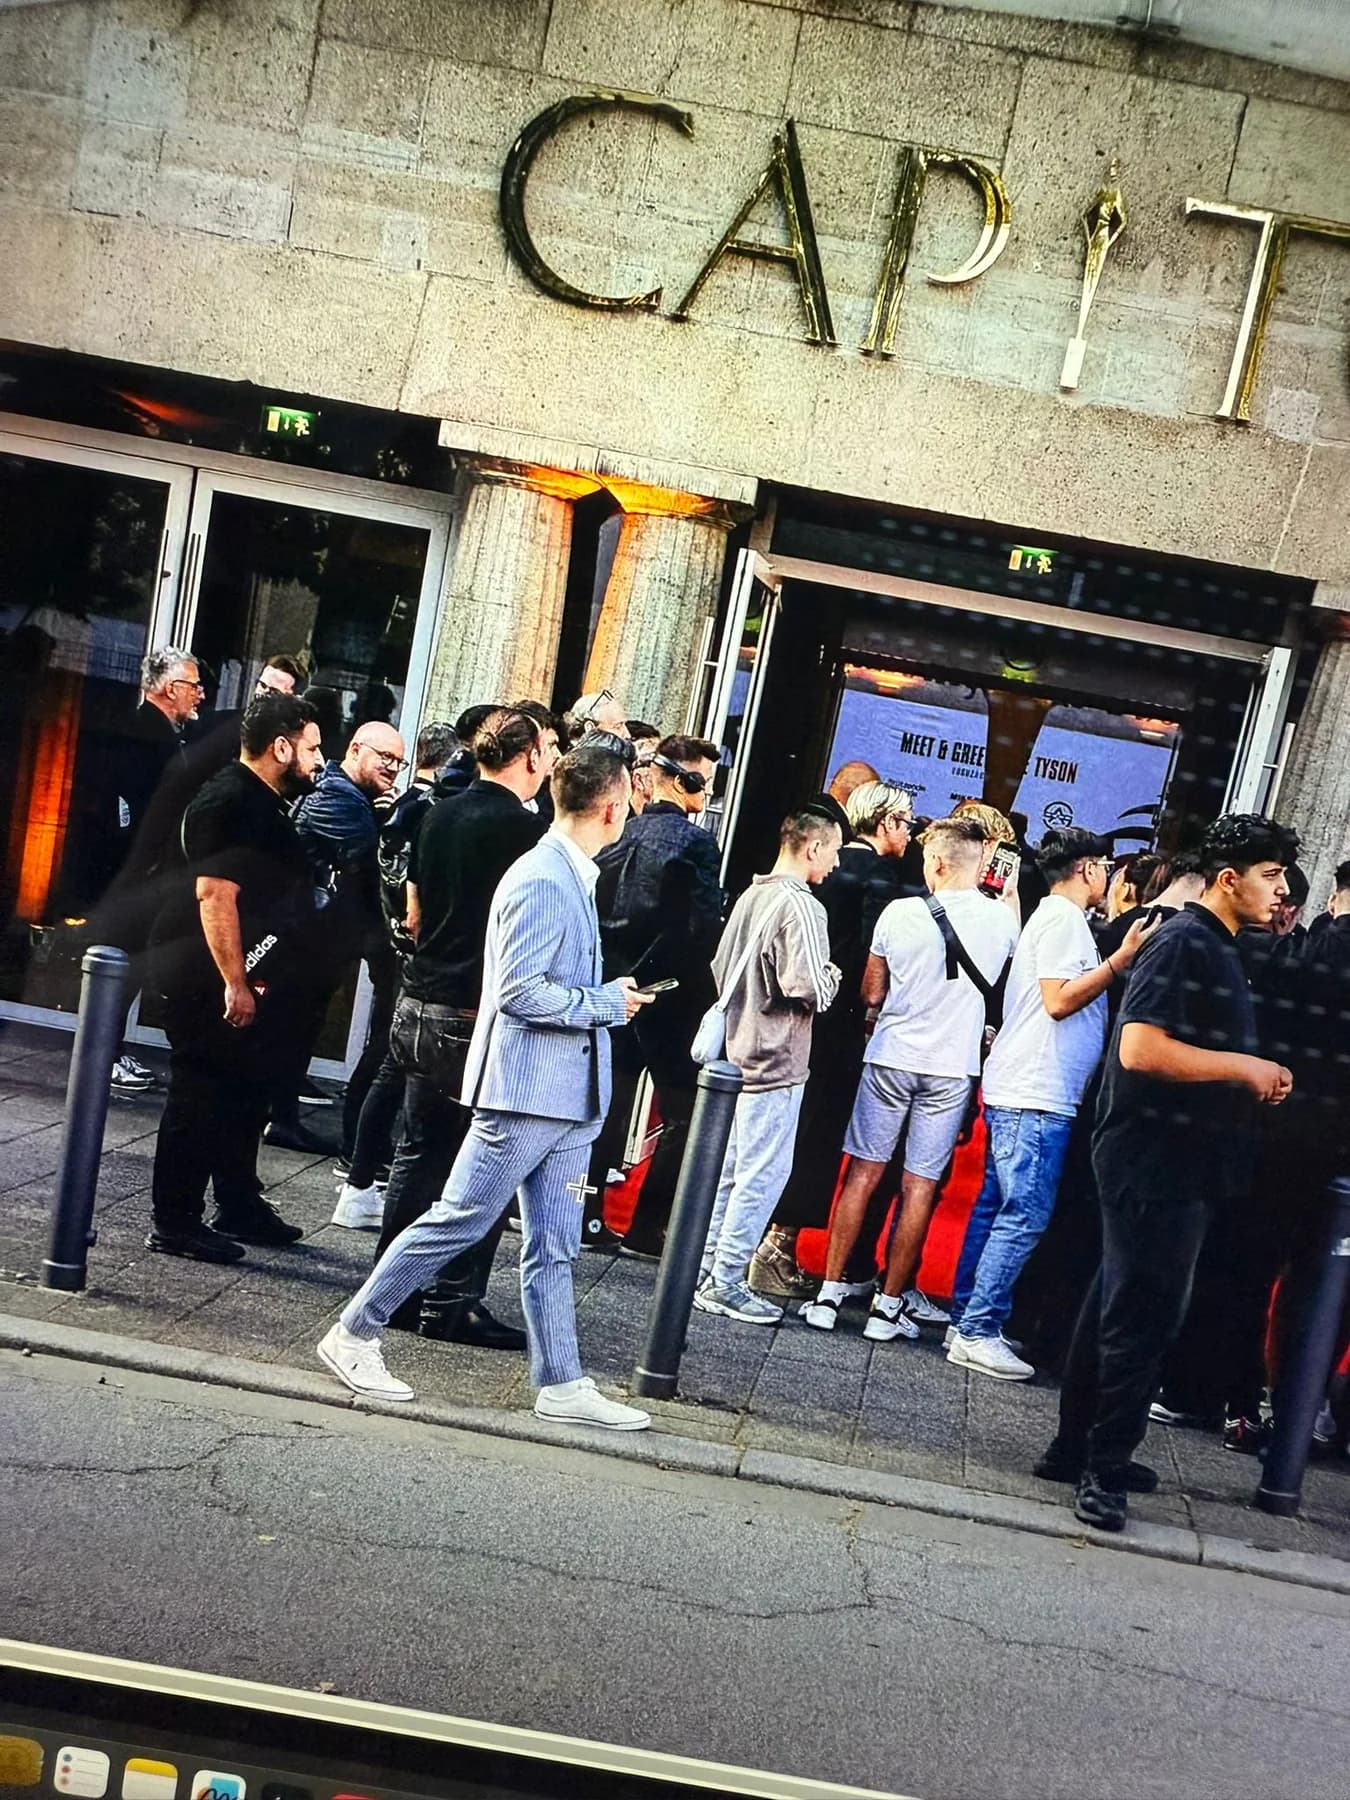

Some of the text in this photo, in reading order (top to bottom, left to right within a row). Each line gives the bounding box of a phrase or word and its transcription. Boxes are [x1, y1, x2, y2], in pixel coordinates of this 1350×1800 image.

[900, 732, 936, 757] MEET
[937, 740, 949, 761] &
[1034, 756, 1078, 785] TYSON
